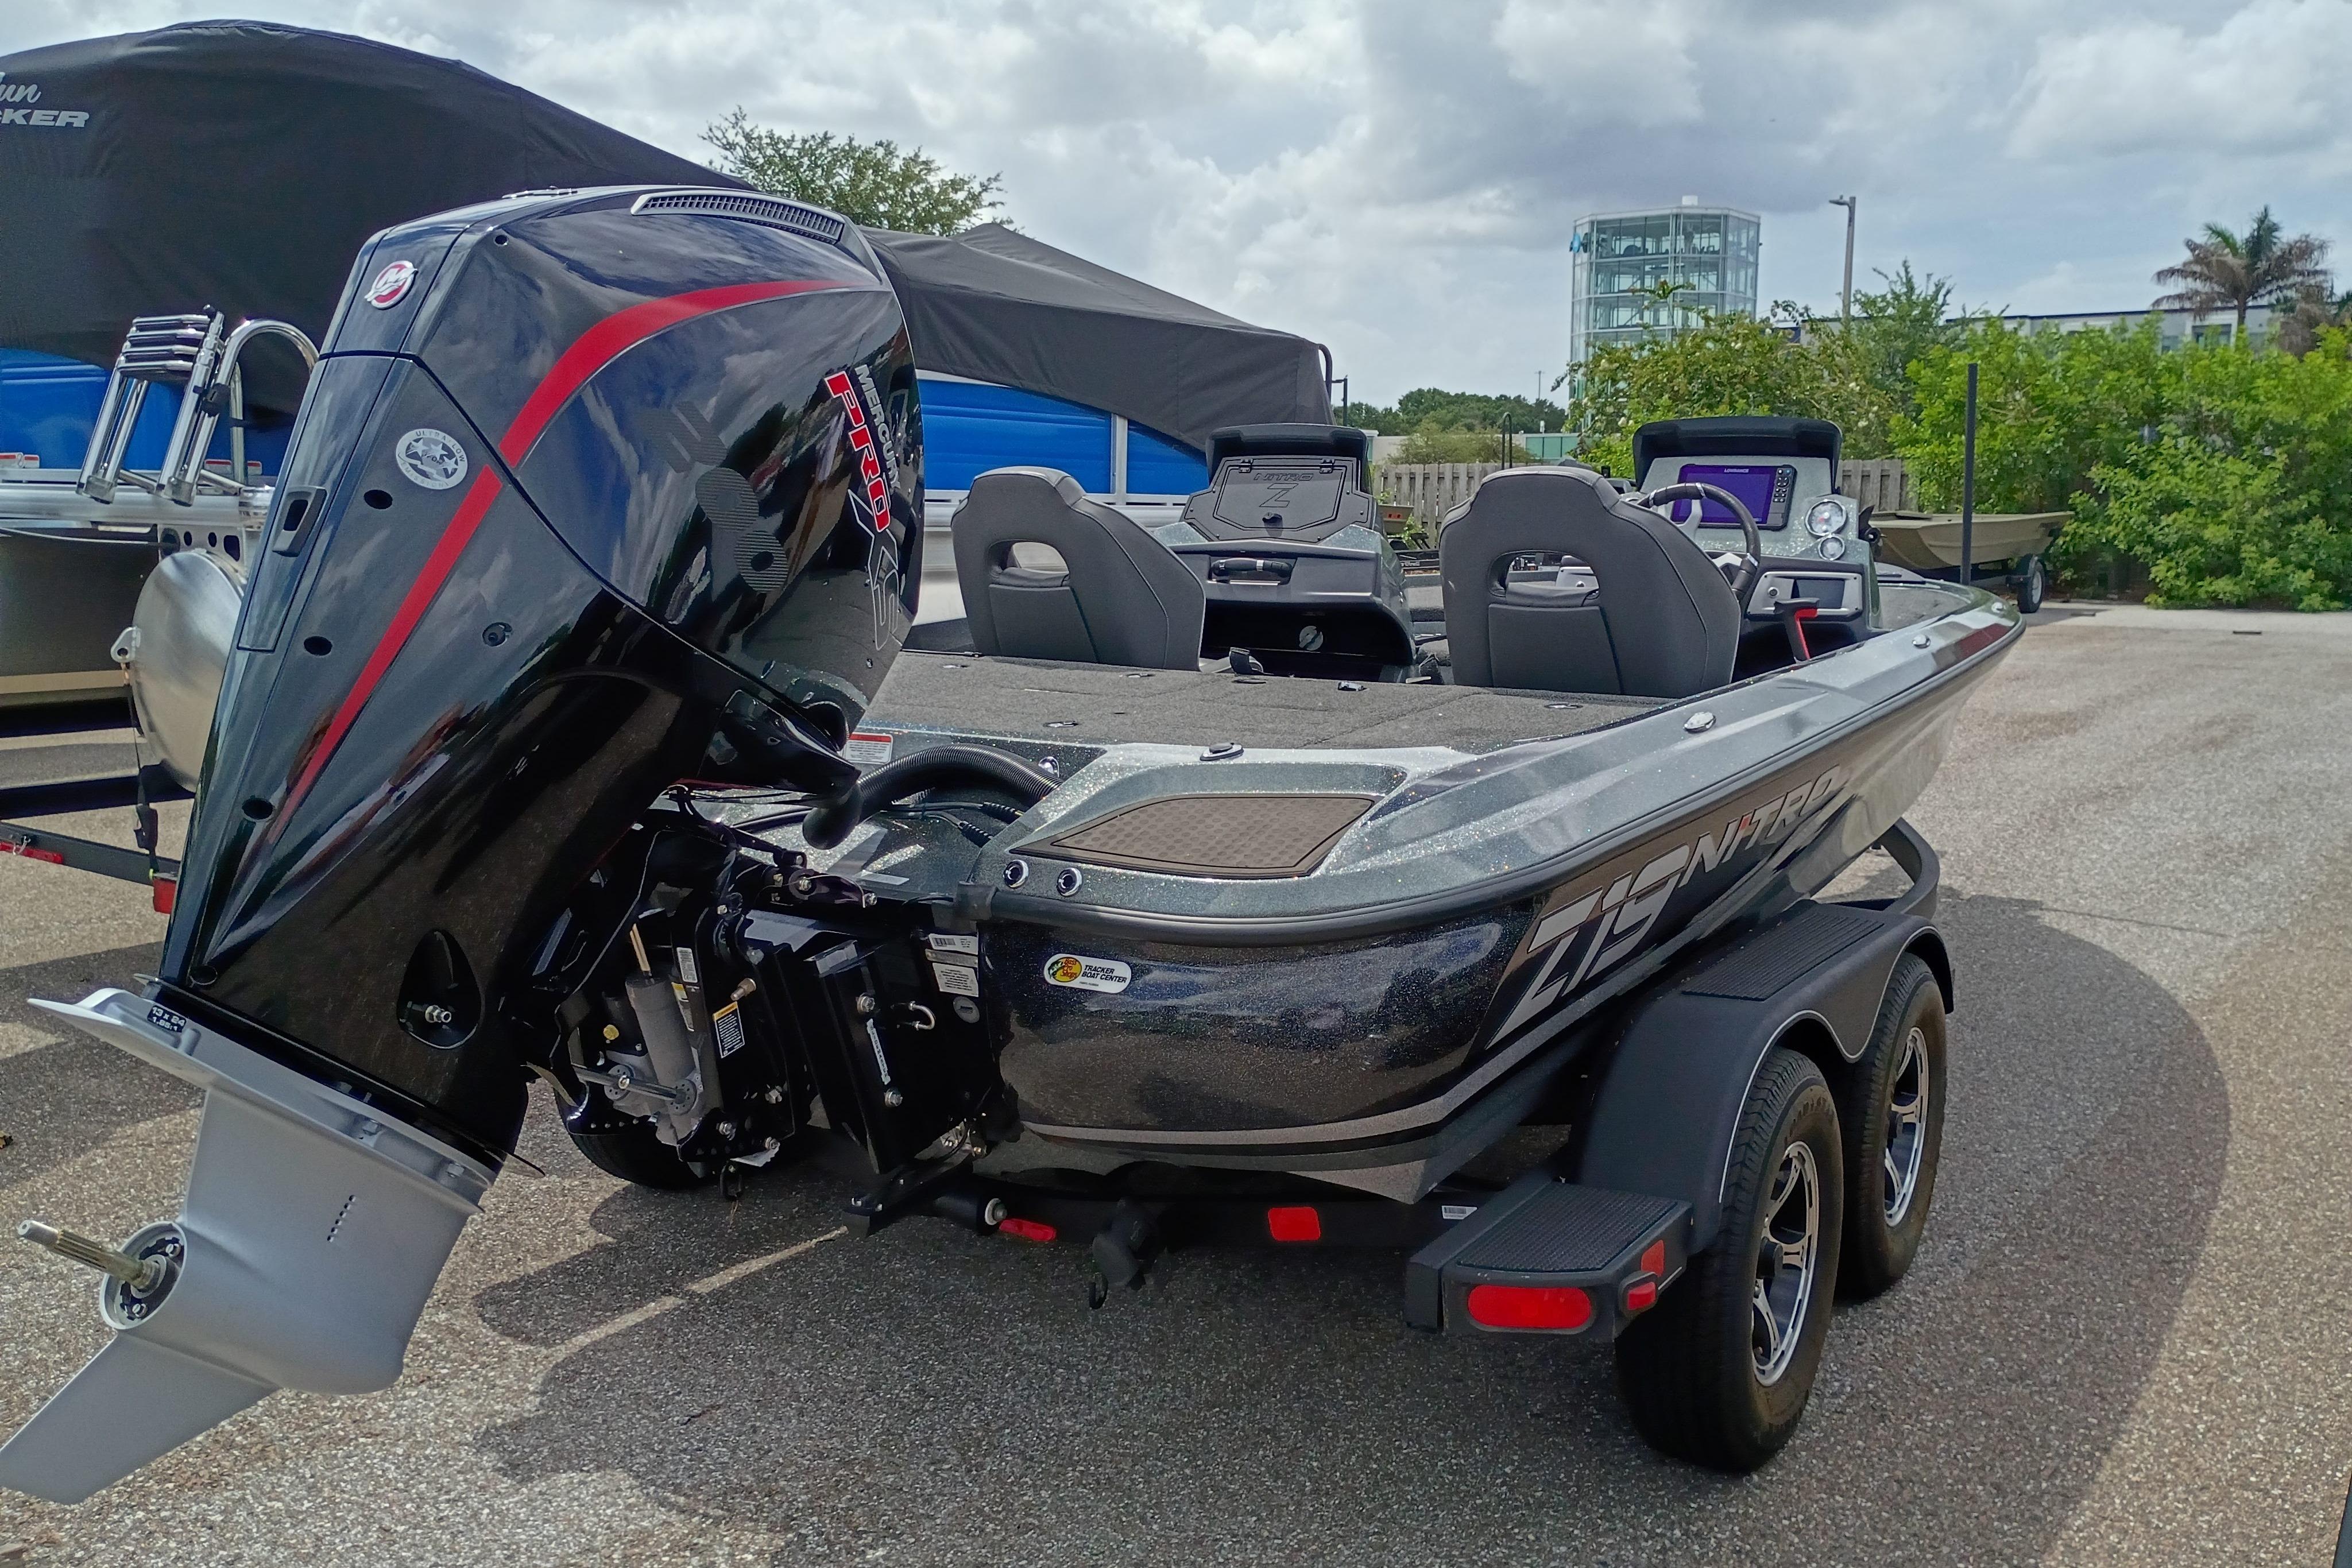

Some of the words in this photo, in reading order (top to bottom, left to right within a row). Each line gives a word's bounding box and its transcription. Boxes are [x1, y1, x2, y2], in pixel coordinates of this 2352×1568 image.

[0, 72, 41, 103] un
[0, 109, 90, 127] KER
[854, 364, 900, 489] MERCURY
[416, 430, 447, 441] ULTRA
[451, 443, 466, 462] LOW
[824, 370, 891, 532] PRO
[1254, 473, 1314, 481] NITRO
[1259, 482, 1299, 508] Z
[848, 472, 900, 651] XS
[1484, 842, 1690, 1050] Z19
[1677, 764, 1850, 888] NITRO
[1081, 971, 1101, 979] BOAT
[1100, 974, 1128, 984] CENTER
[1084, 965, 1115, 974] TRACKER
[152, 1006, 164, 1017] 13
[171, 1016, 185, 1027] 24
